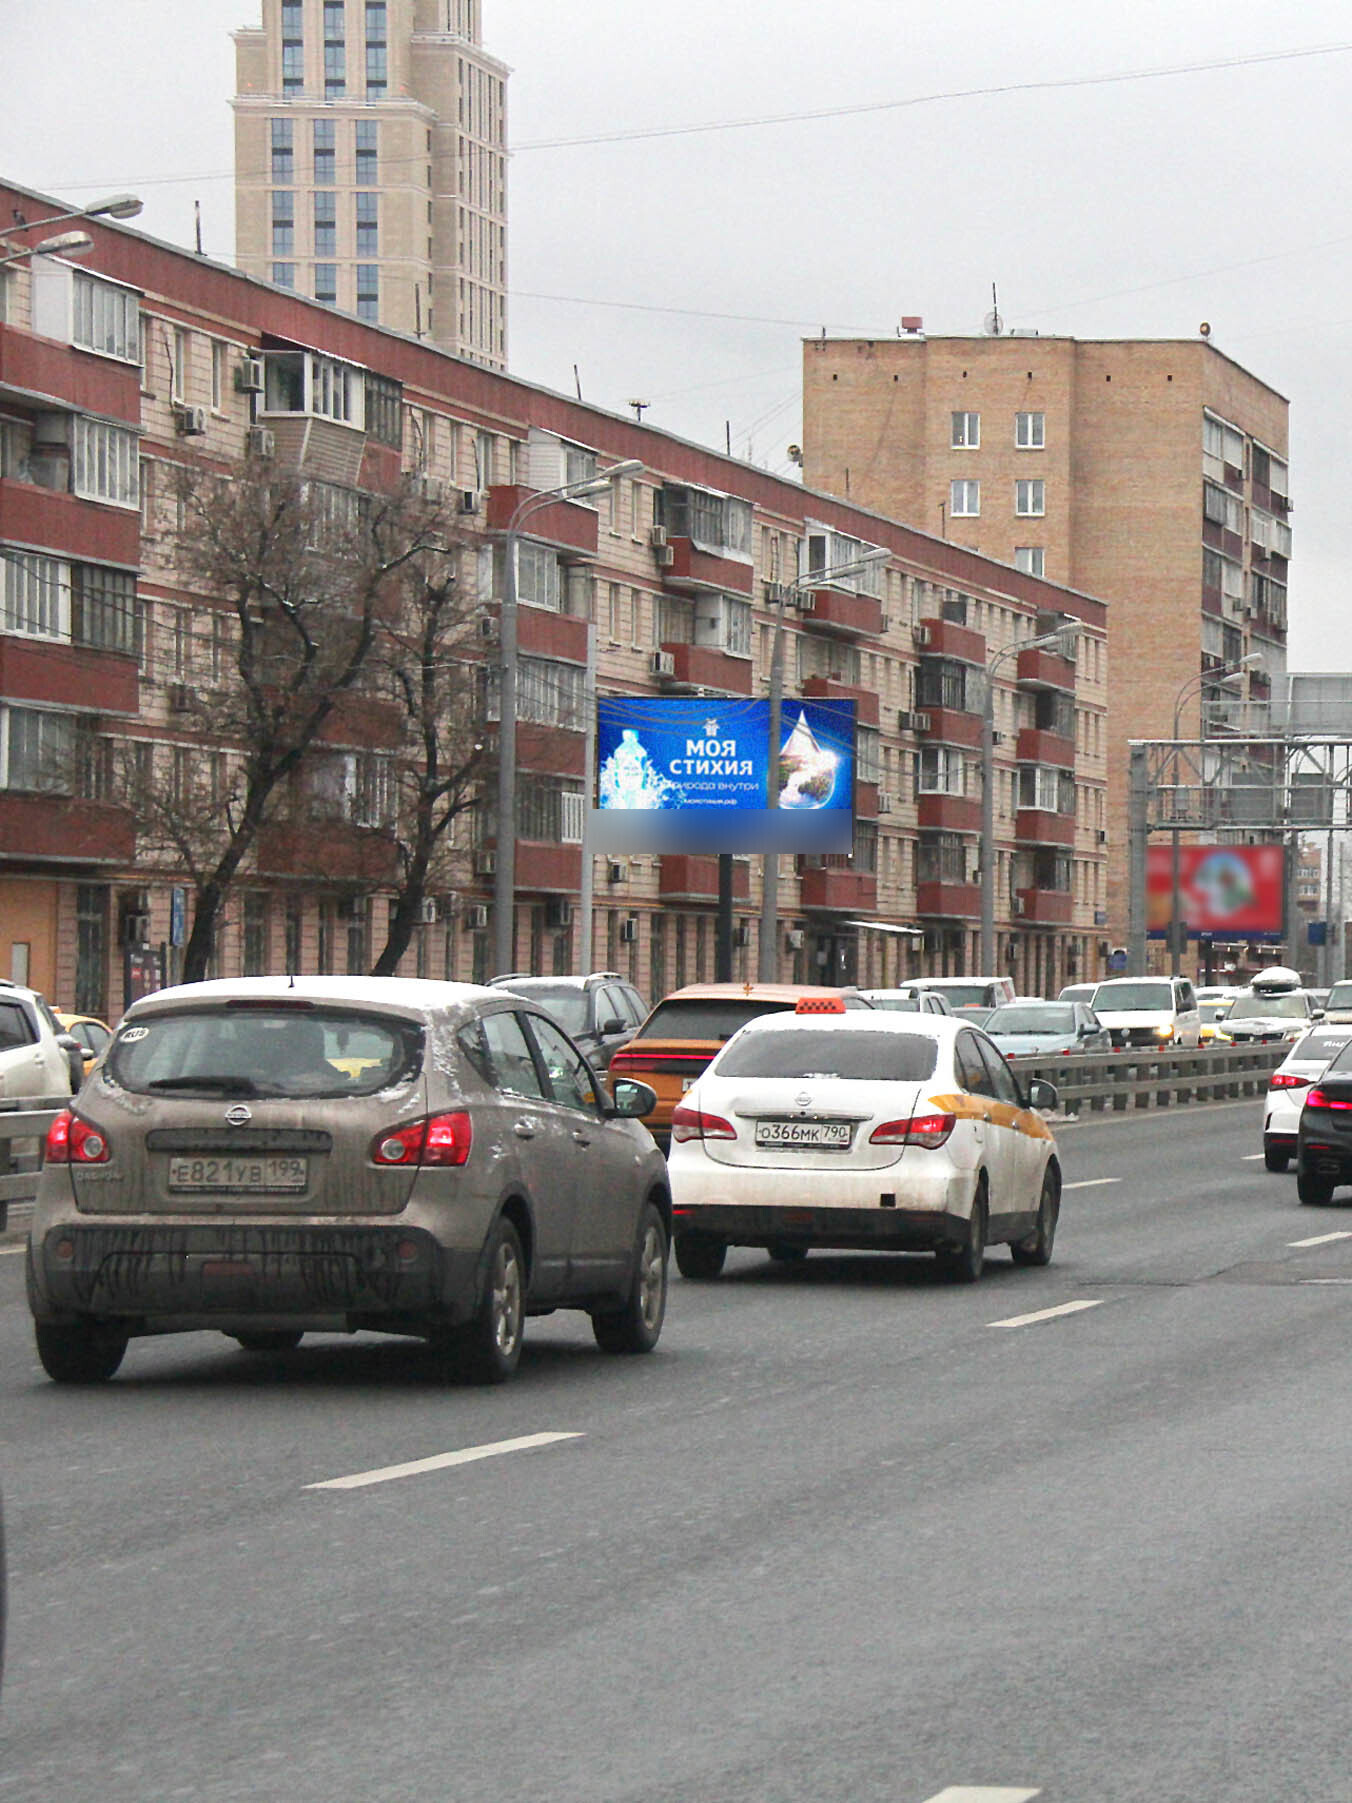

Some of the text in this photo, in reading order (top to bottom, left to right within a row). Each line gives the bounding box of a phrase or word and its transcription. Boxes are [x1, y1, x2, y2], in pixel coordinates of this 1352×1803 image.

[686, 739, 736, 757] МОЯ
[669, 759, 753, 776] СТИХИЯ
[823, 1125, 846, 1138] 790
[268, 1160, 300, 1177] 199
